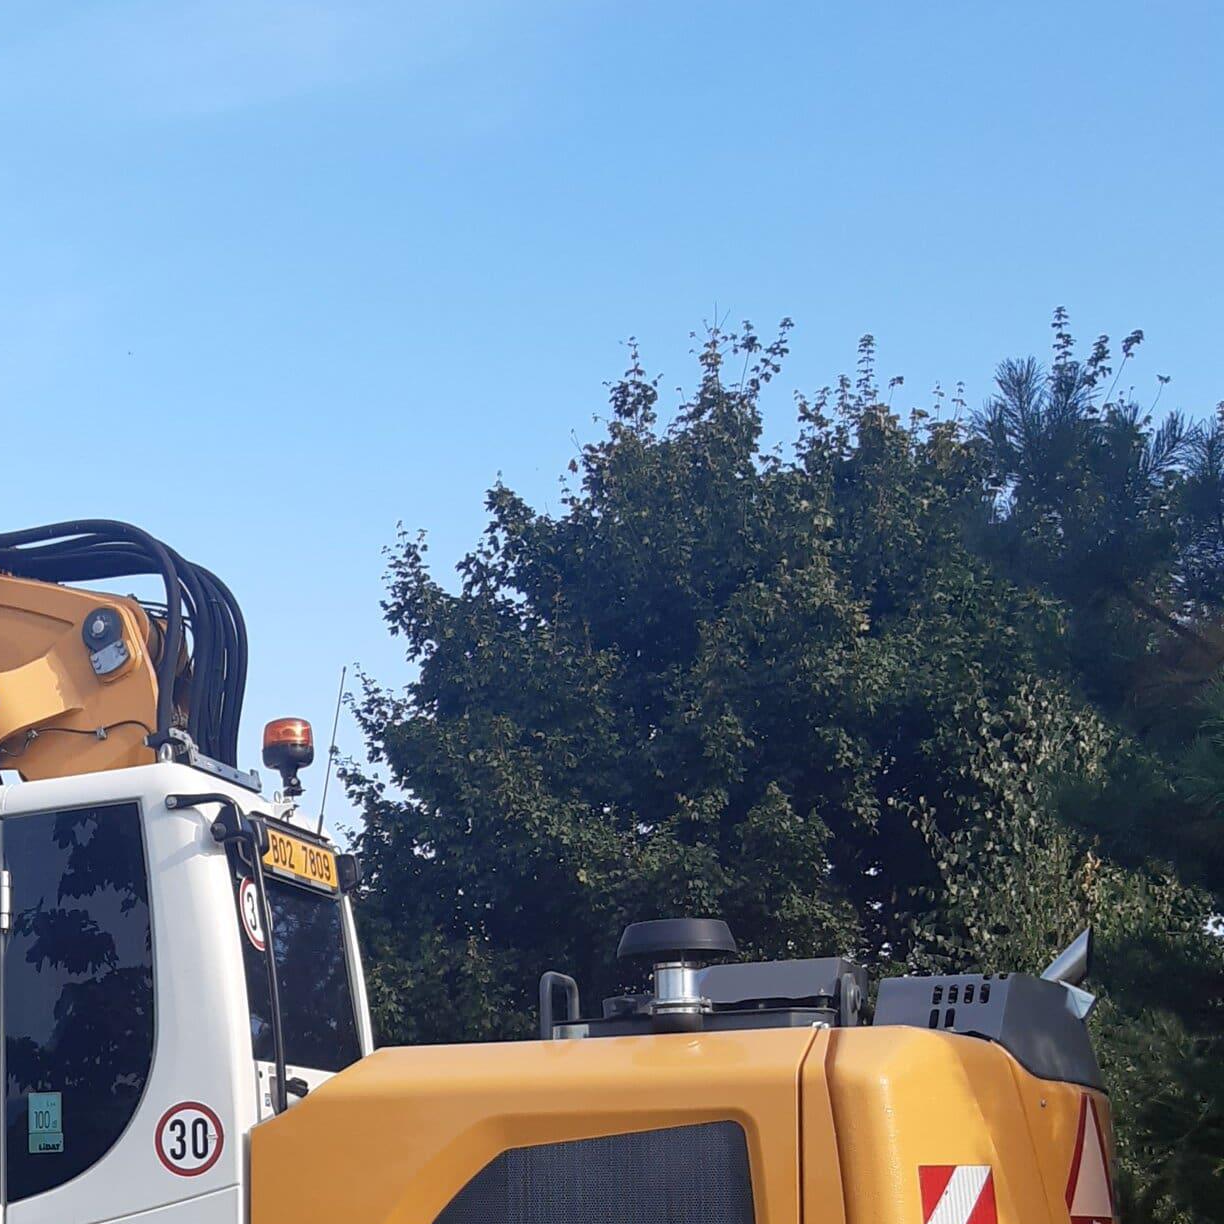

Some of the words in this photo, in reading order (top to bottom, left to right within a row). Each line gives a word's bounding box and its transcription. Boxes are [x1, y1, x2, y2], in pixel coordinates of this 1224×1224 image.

[271, 834, 295, 869] B02
[302, 846, 331, 881] 7809
[247, 892, 257, 931] 3
[34, 1110, 51, 1129] 100
[169, 1117, 209, 1161] 30
